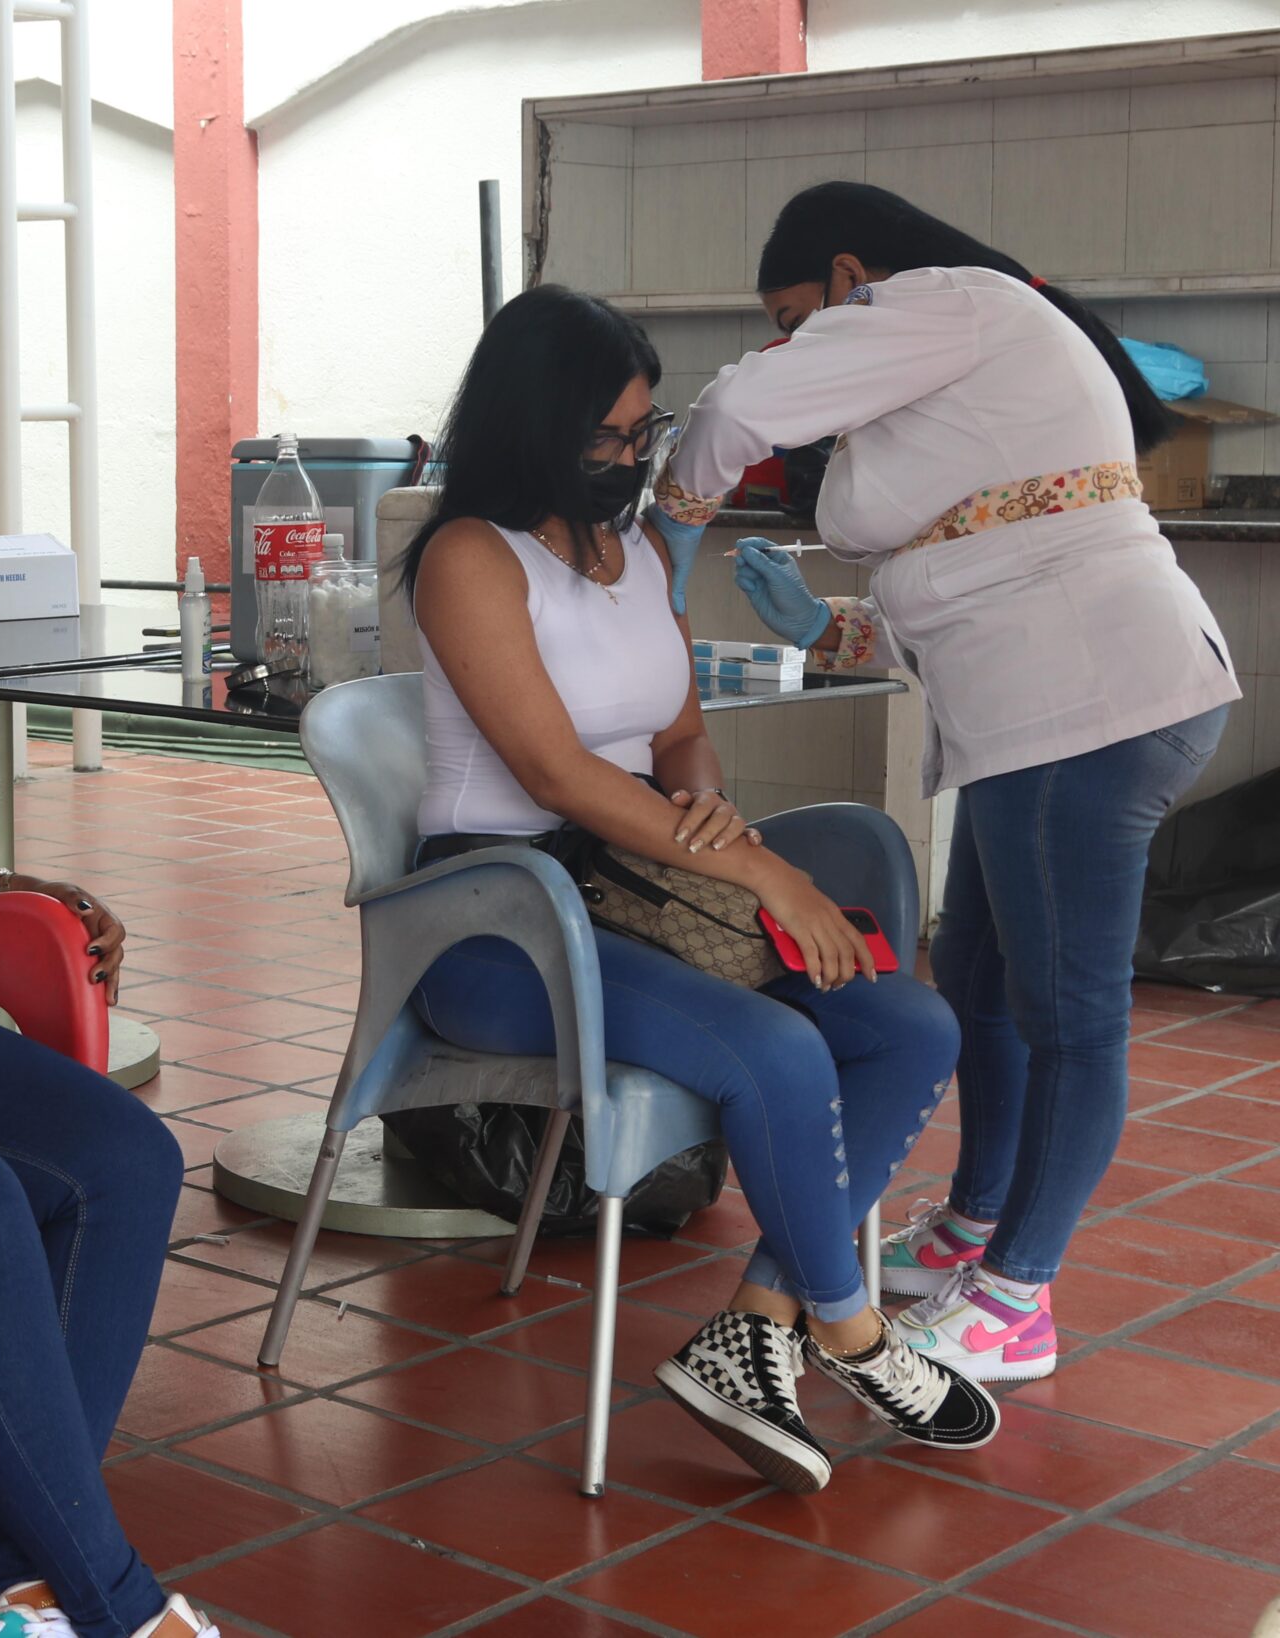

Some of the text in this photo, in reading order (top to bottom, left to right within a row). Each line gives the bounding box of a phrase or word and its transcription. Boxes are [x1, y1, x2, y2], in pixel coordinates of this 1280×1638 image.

[285, 527, 322, 544] Coca-Cola
[5, 573, 26, 582] NEEDLE
[1032, 1341, 1048, 1354] AIR
